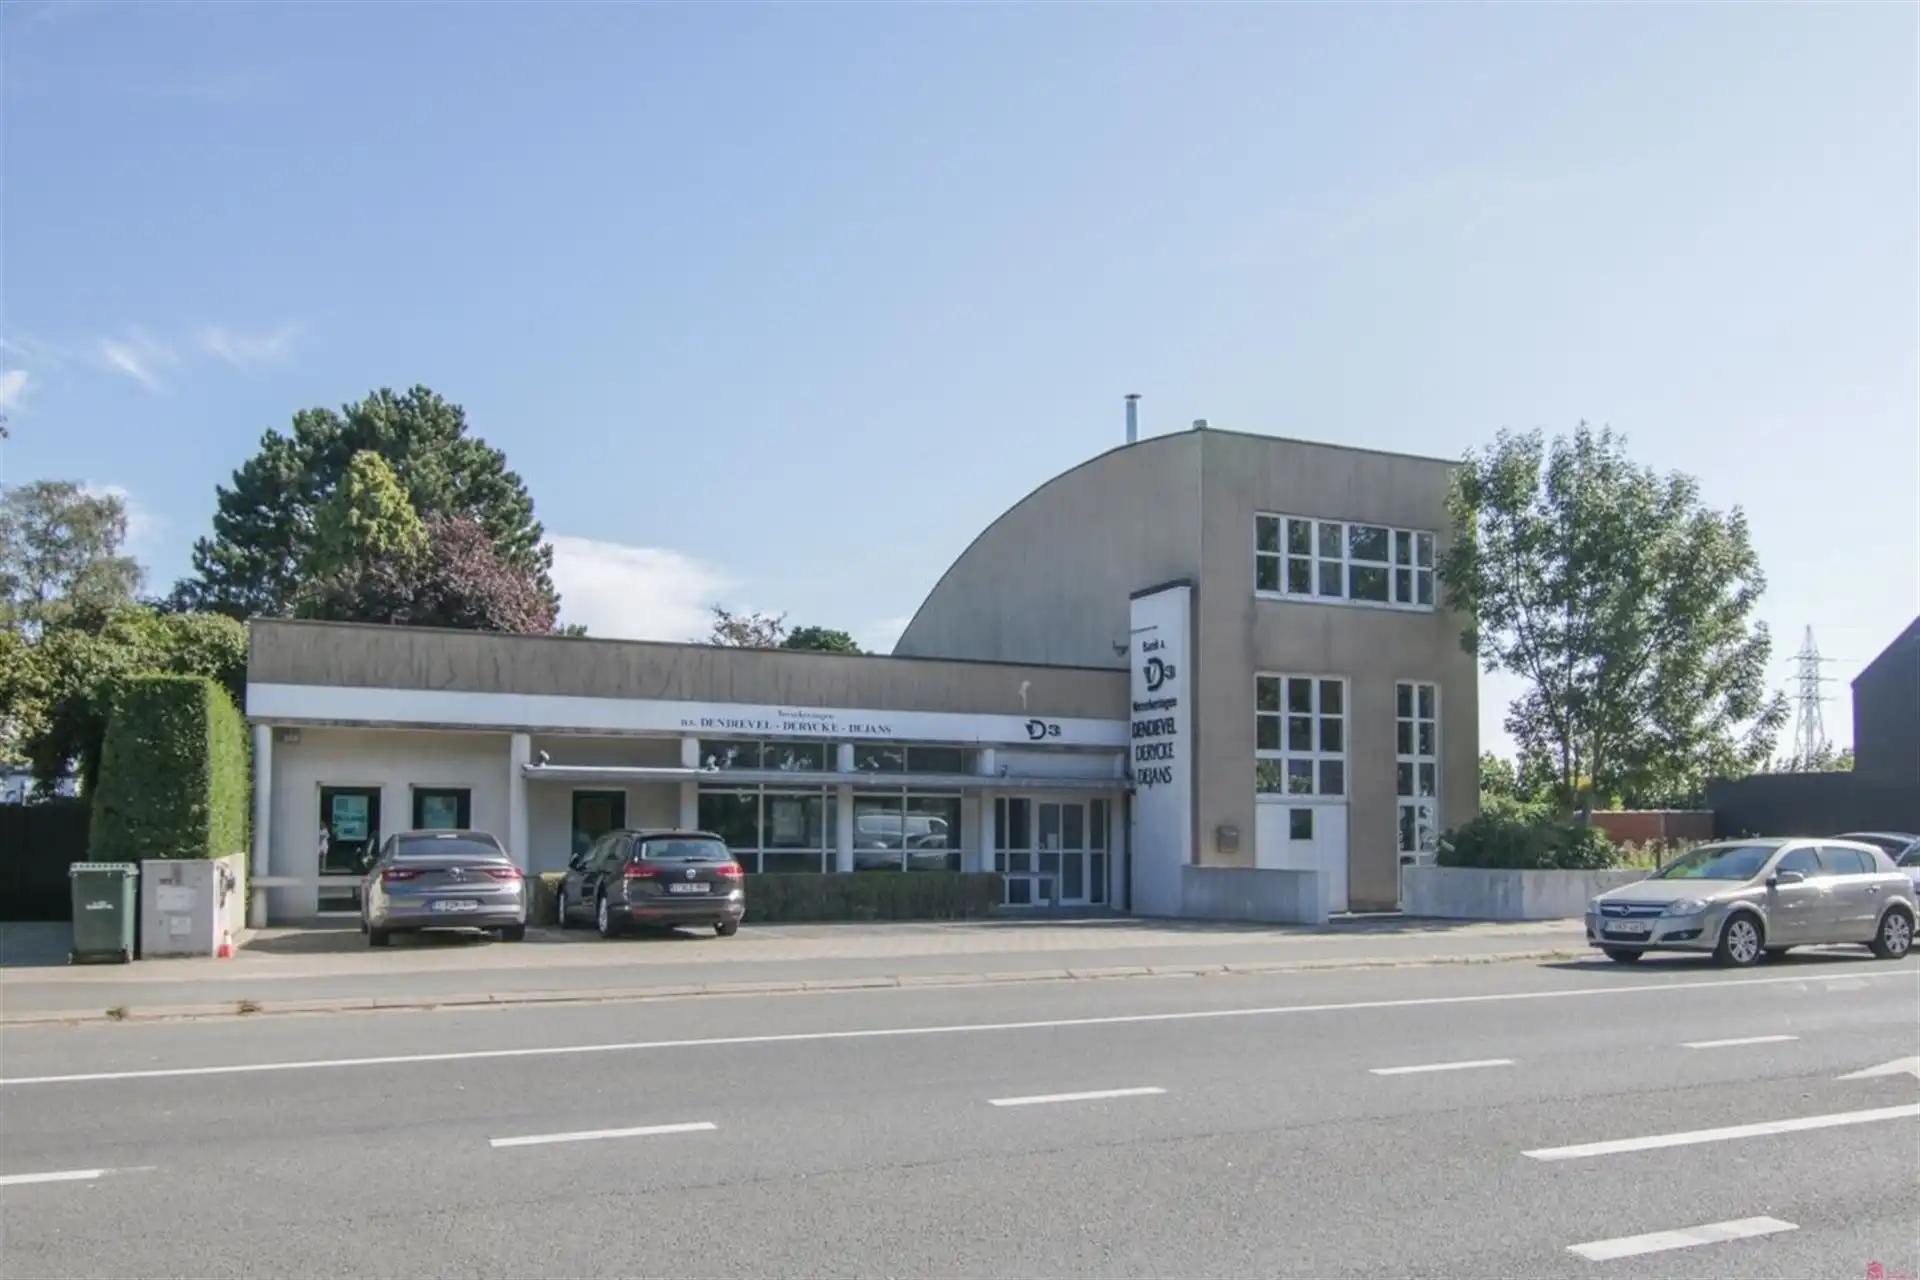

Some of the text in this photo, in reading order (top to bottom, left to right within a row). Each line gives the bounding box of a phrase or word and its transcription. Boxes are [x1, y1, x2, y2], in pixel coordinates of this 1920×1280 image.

[783, 721, 839, 732] DERYCKE
[849, 723, 892, 734] DEJANS
[1132, 717, 1177, 738] DENDIEVEL
[1136, 742, 1174, 761] DERYCKE
[1137, 766, 1172, 790] DEJANS
